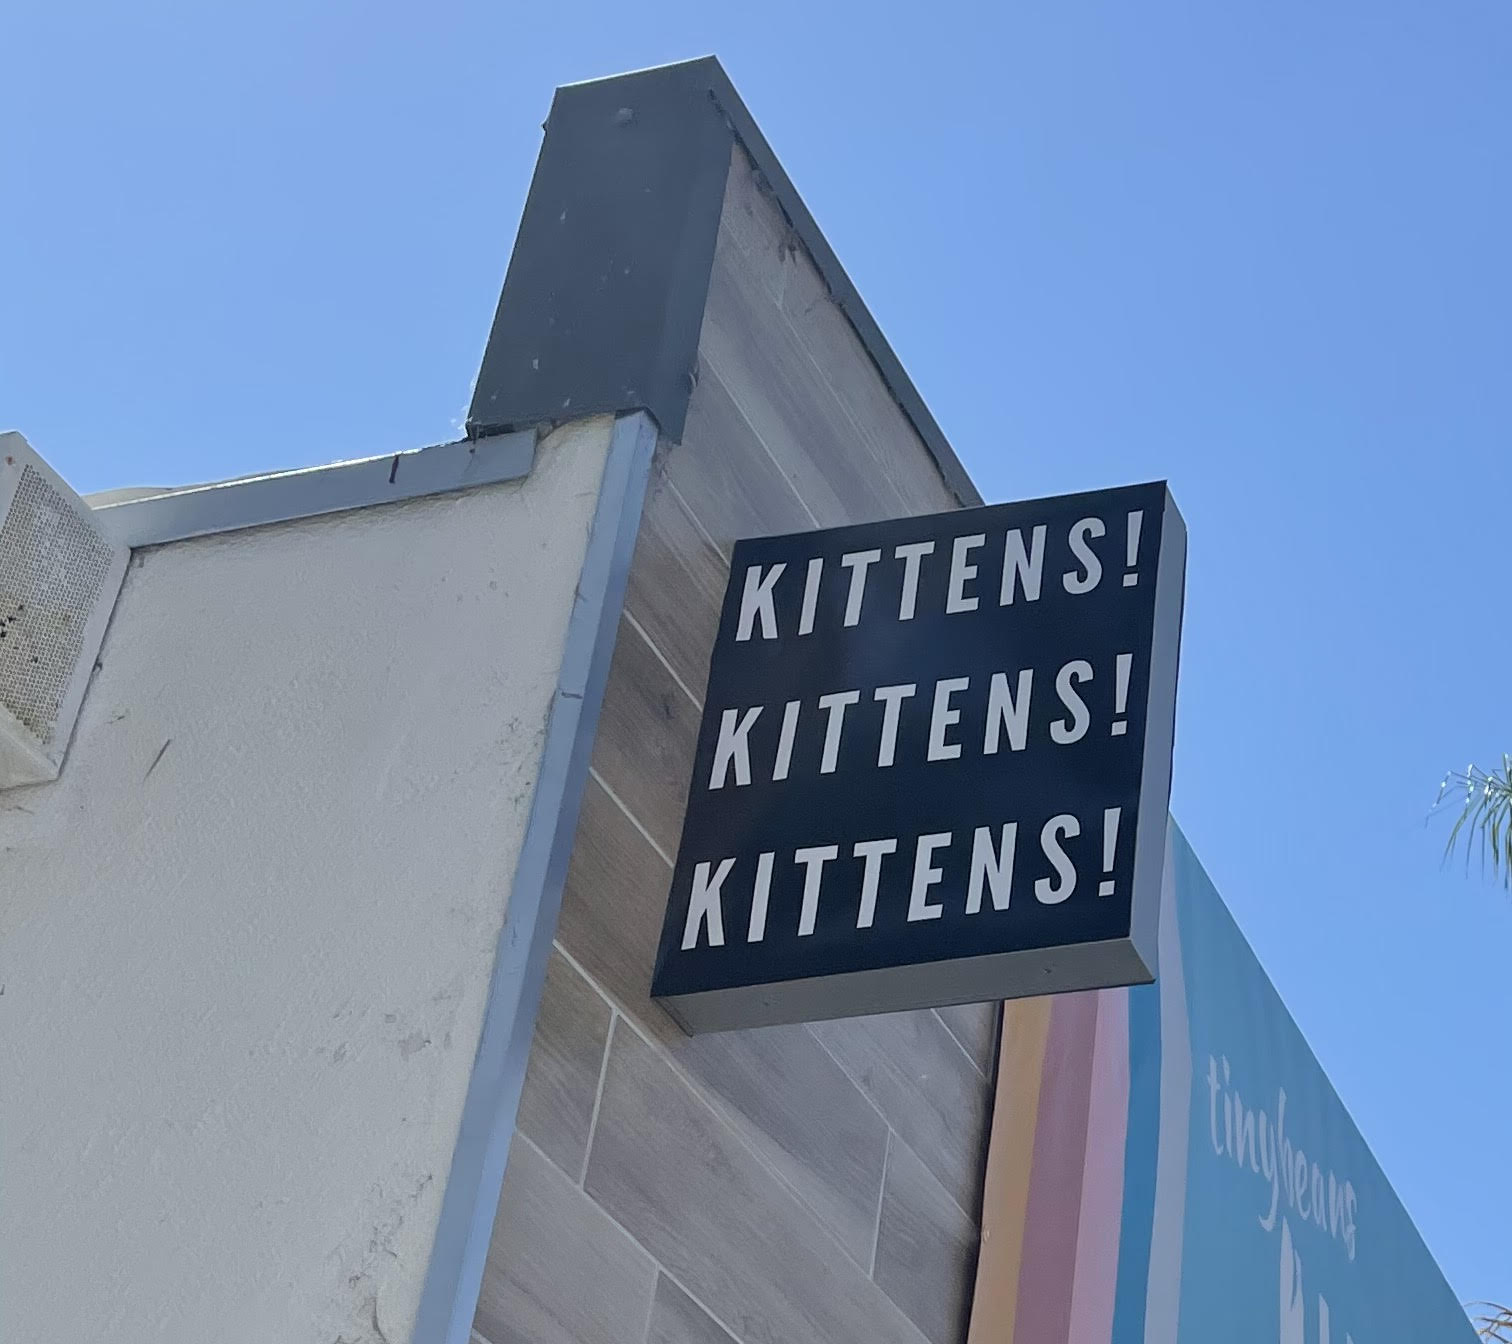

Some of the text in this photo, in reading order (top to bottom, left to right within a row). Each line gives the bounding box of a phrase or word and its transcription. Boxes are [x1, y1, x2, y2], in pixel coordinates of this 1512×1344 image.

[735, 510, 1144, 642] KITTENS!
[707, 653, 1134, 790] KITTENS!
[680, 807, 1122, 951] KITTENS!
[1206, 1053, 1358, 1263] tinybeans
